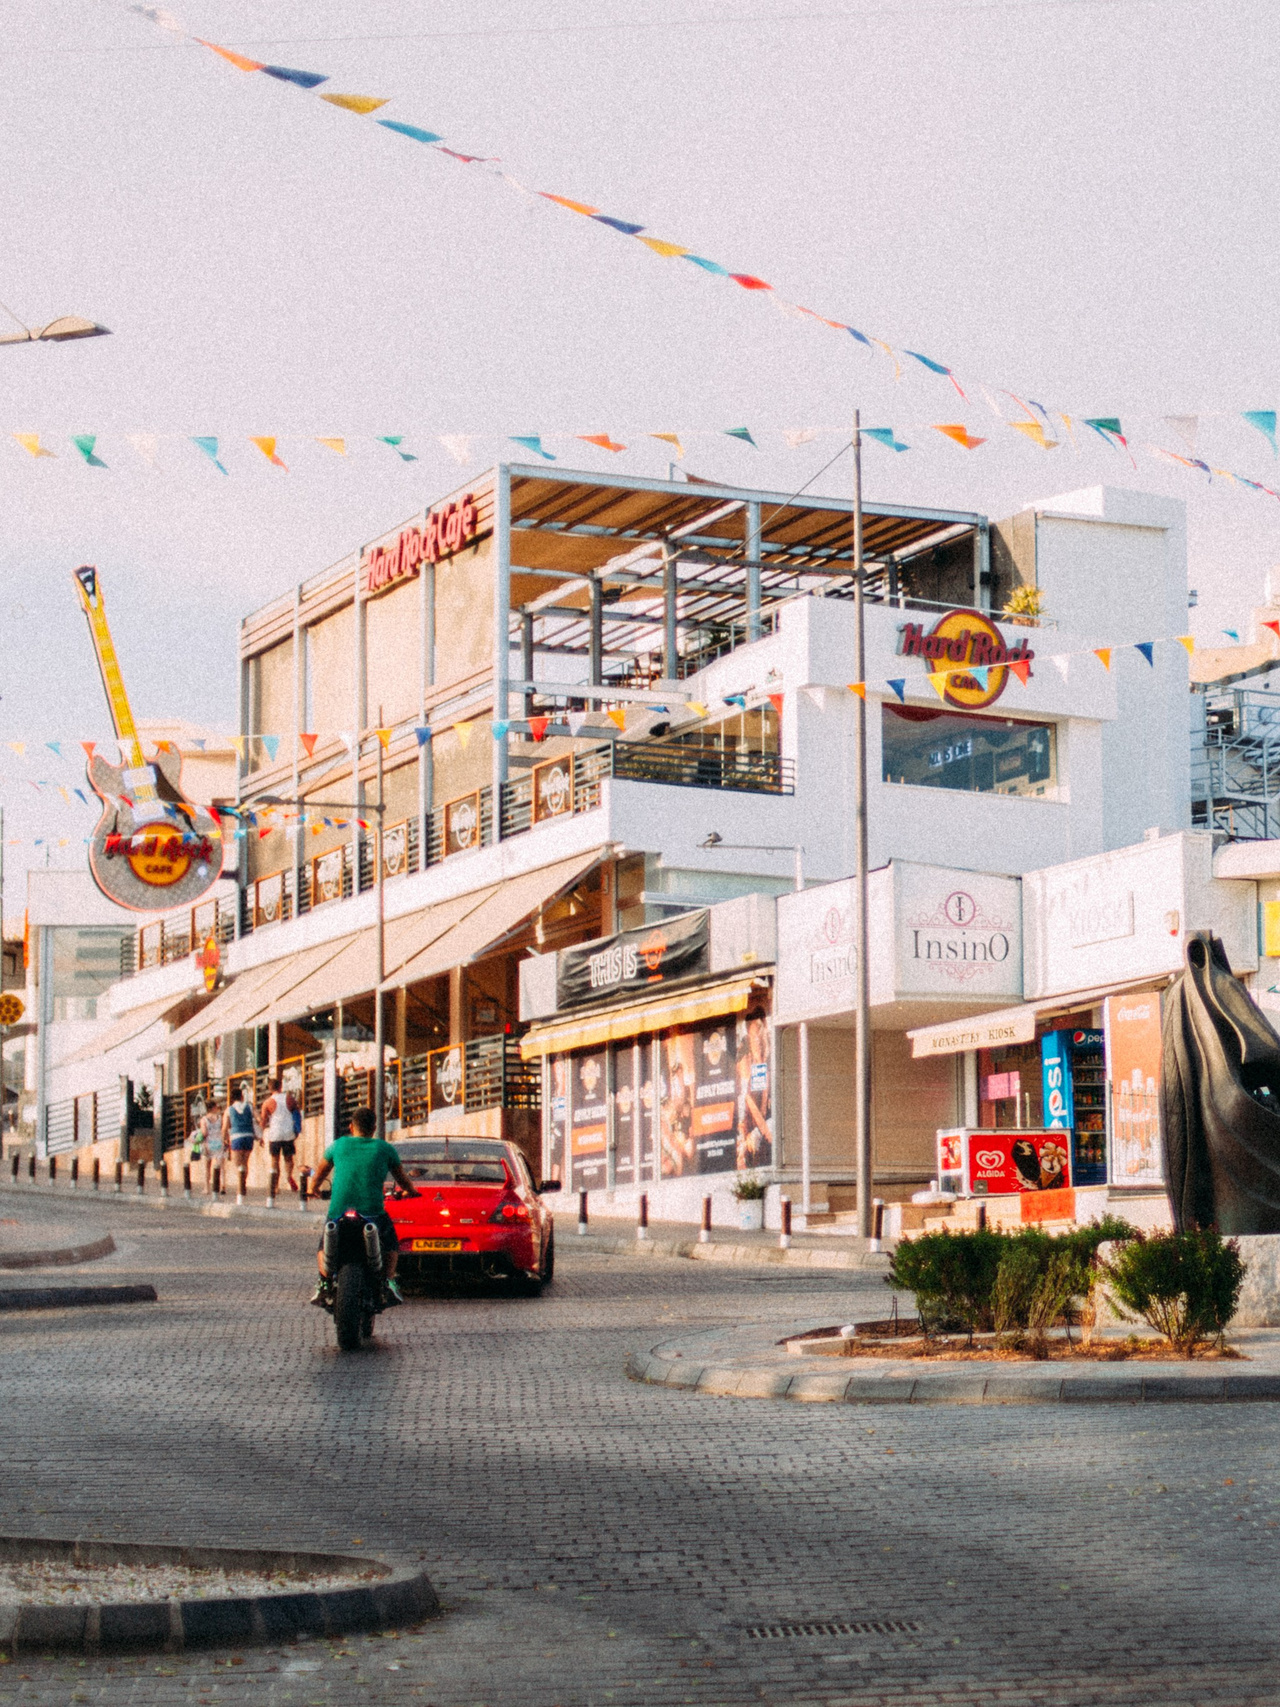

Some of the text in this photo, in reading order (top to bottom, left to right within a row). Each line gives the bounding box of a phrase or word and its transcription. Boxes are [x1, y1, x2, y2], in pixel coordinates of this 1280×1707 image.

[366, 531, 402, 592] Hard
[401, 512, 438, 576] Rock
[901, 622, 1035, 678] Hard Rock
[951, 674, 988, 692] CAF
[161, 836, 214, 863] Rock
[145, 864, 173, 874] CAFE
[589, 947, 622, 988] THIS
[622, 943, 638, 980] IS
[988, 1026, 1016, 1040] KIOSK
[1087, 1034, 1104, 1043] pep
